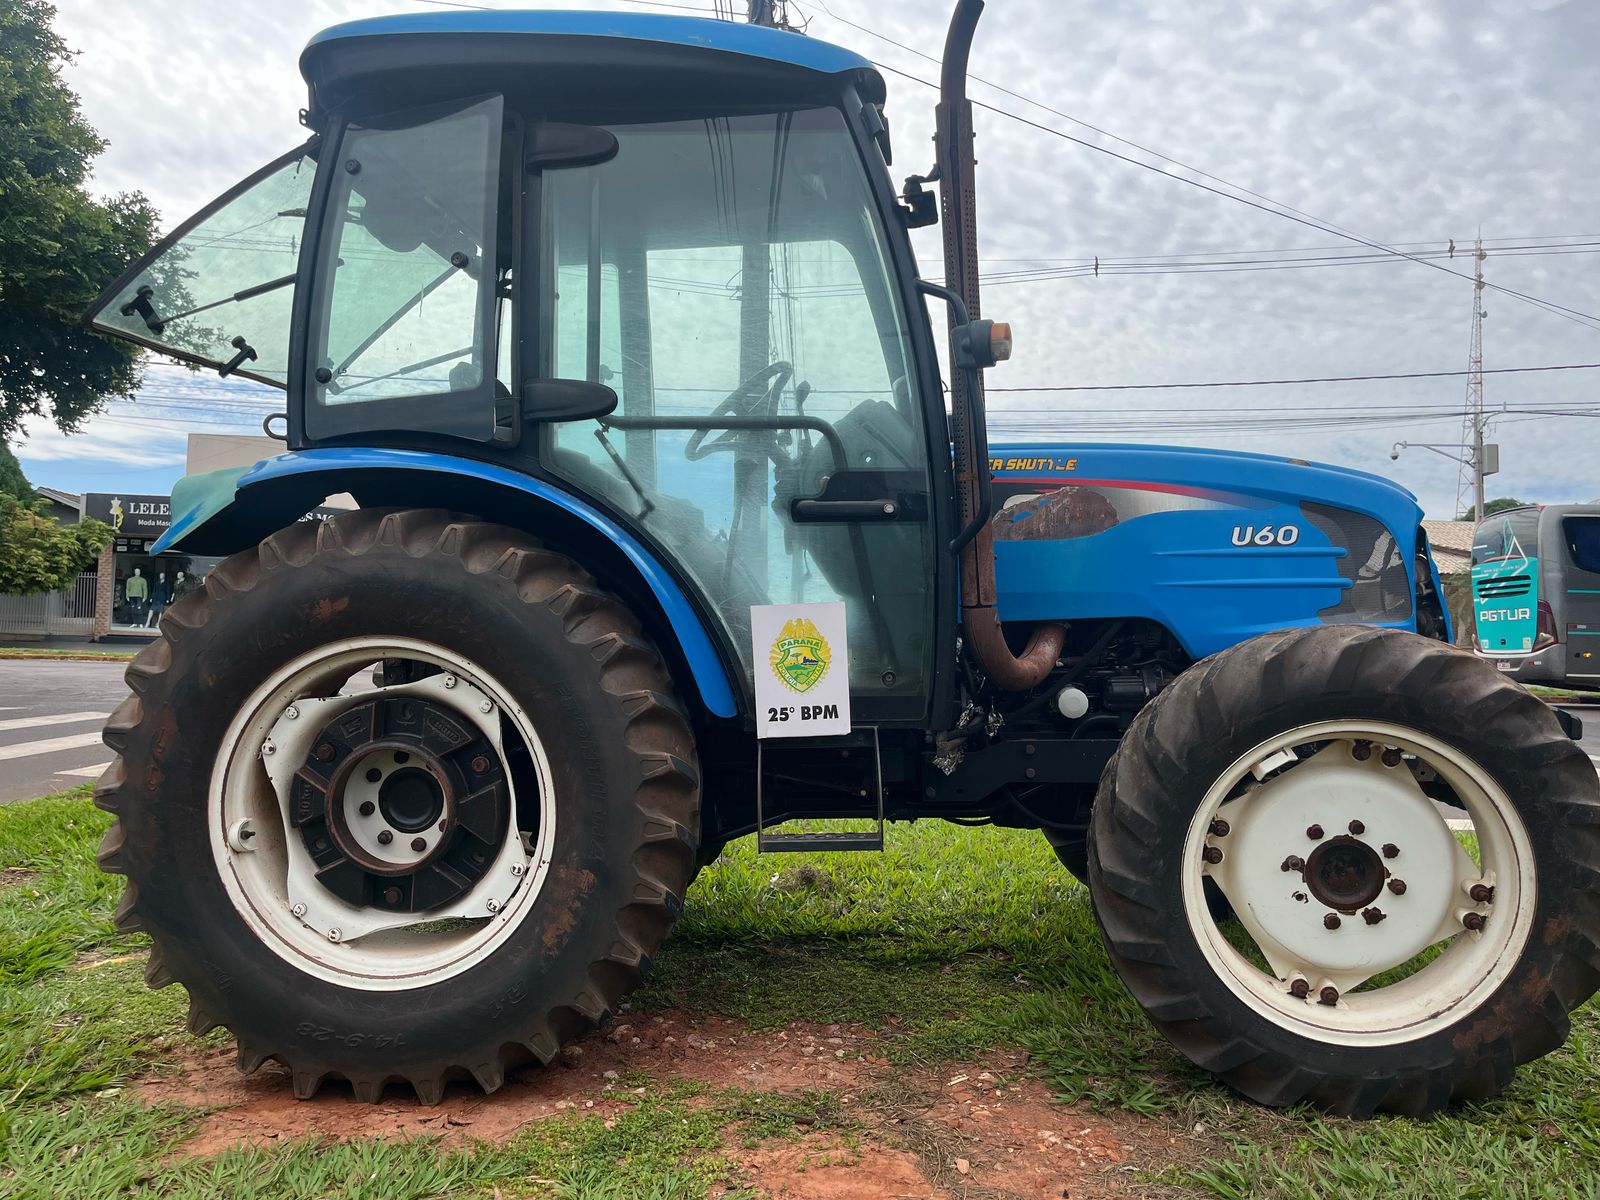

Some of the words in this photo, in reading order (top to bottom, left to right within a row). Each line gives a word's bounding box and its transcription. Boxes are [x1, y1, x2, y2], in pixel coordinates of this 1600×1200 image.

[1231, 525, 1299, 546] U60
[1480, 608, 1530, 621] PGTUR
[805, 663, 823, 686] MILITAR
[800, 704, 839, 720] BPM
